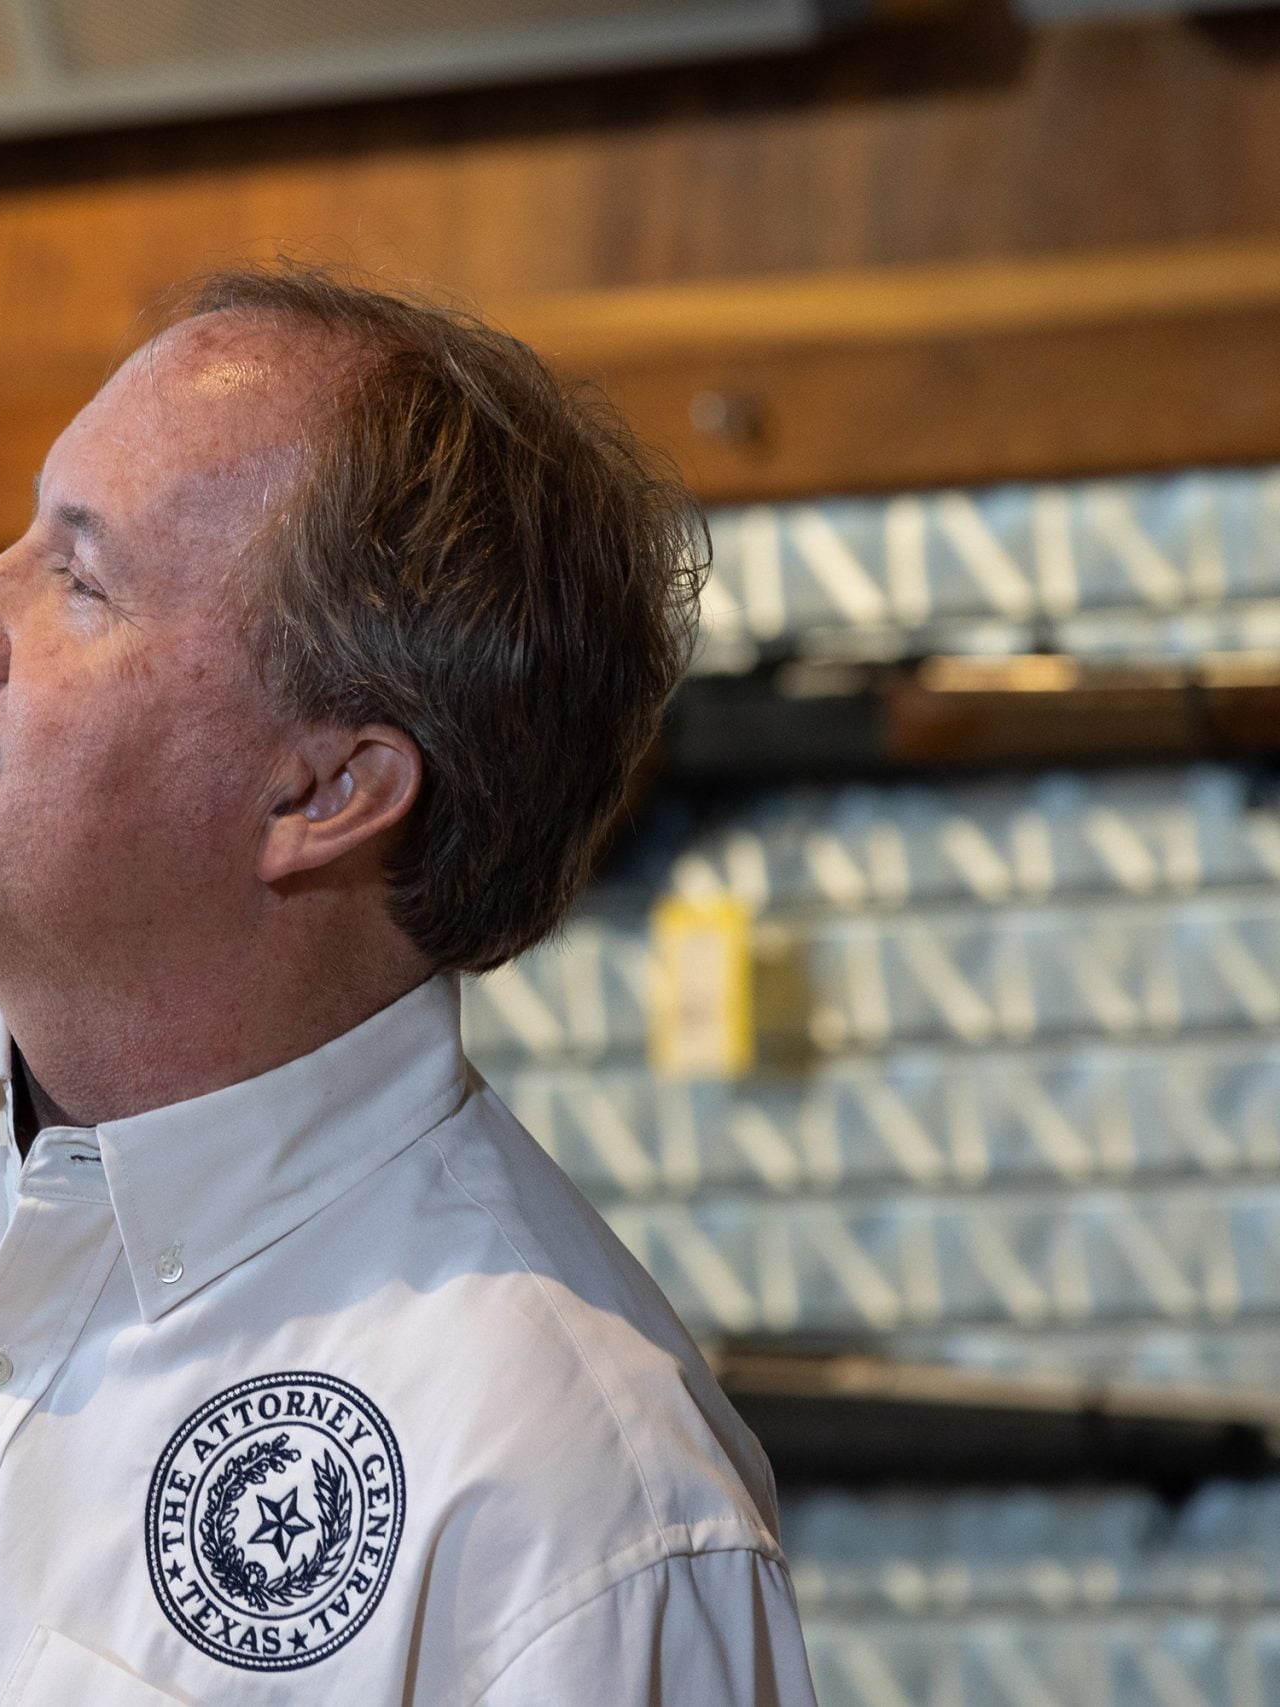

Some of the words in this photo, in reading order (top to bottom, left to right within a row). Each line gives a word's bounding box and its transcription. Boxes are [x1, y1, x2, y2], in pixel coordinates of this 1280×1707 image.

[162, 1469, 197, 1553] THE
[192, 1391, 372, 1463] ATTORNEY
[308, 1454, 390, 1635] GENERAL
[177, 1580, 282, 1656] TEXAS
